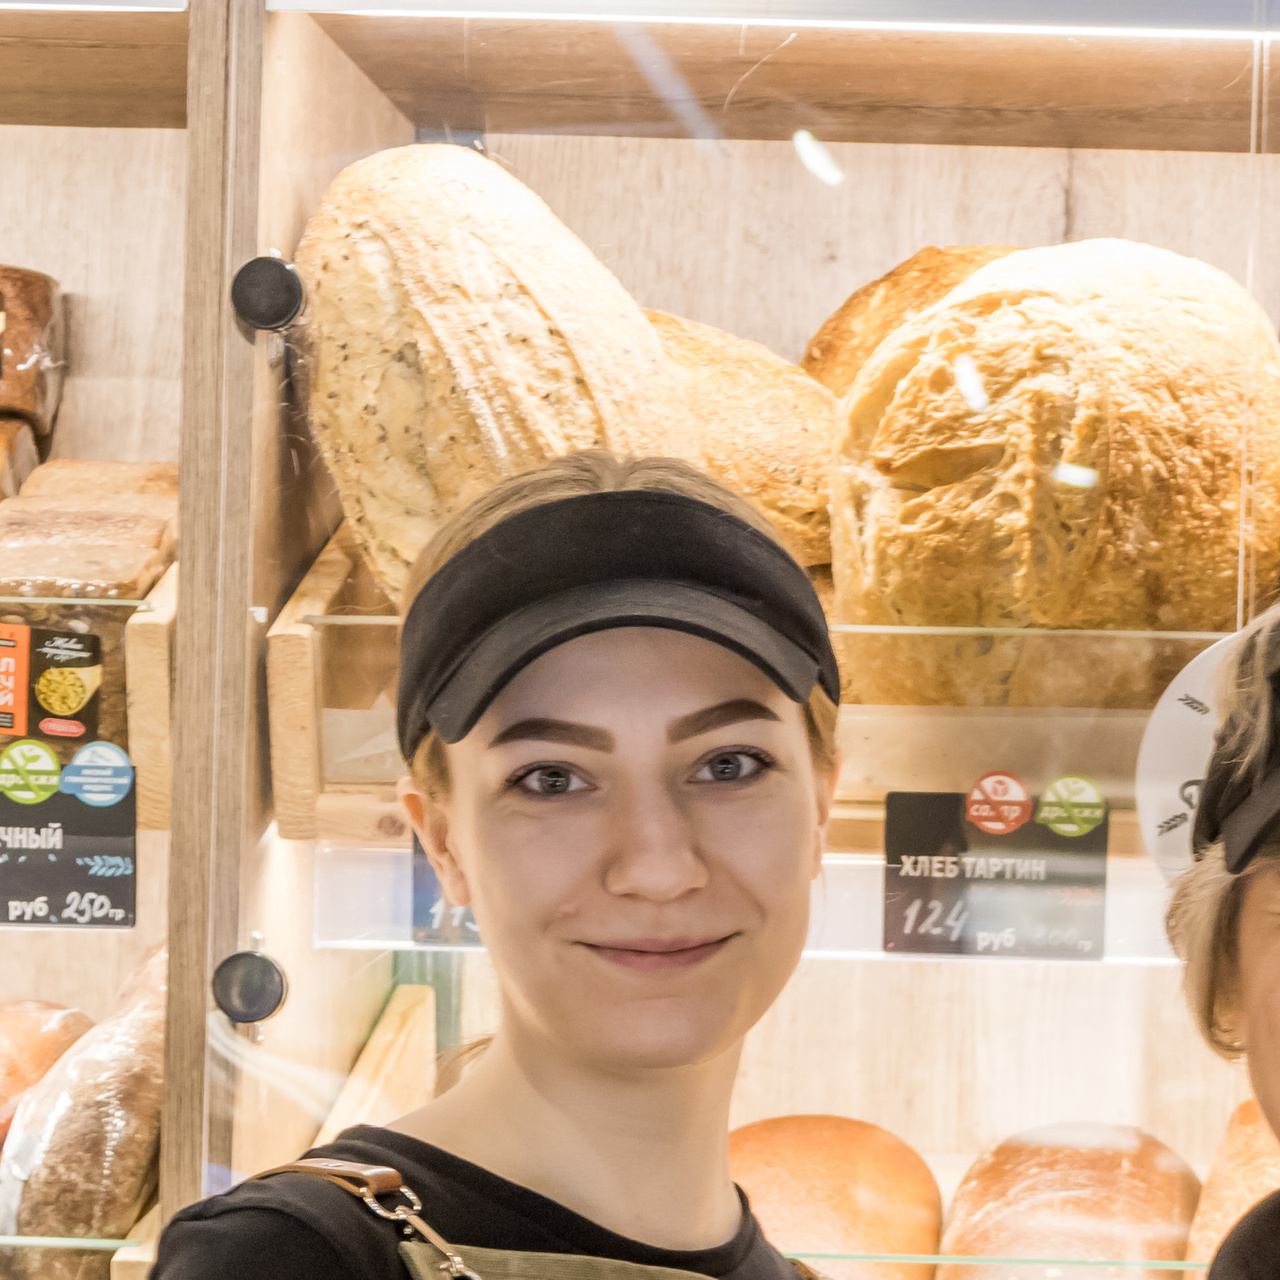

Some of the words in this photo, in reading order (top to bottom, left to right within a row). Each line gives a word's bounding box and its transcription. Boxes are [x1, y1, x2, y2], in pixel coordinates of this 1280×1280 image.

[900, 855, 960, 878] ХЛЕБ
[961, 857, 1047, 881] ТАРТИН
[8, 897, 49, 920] руб
[61, 891, 111, 924] 250
[903, 898, 970, 941] 124
[976, 927, 1017, 951] руб
